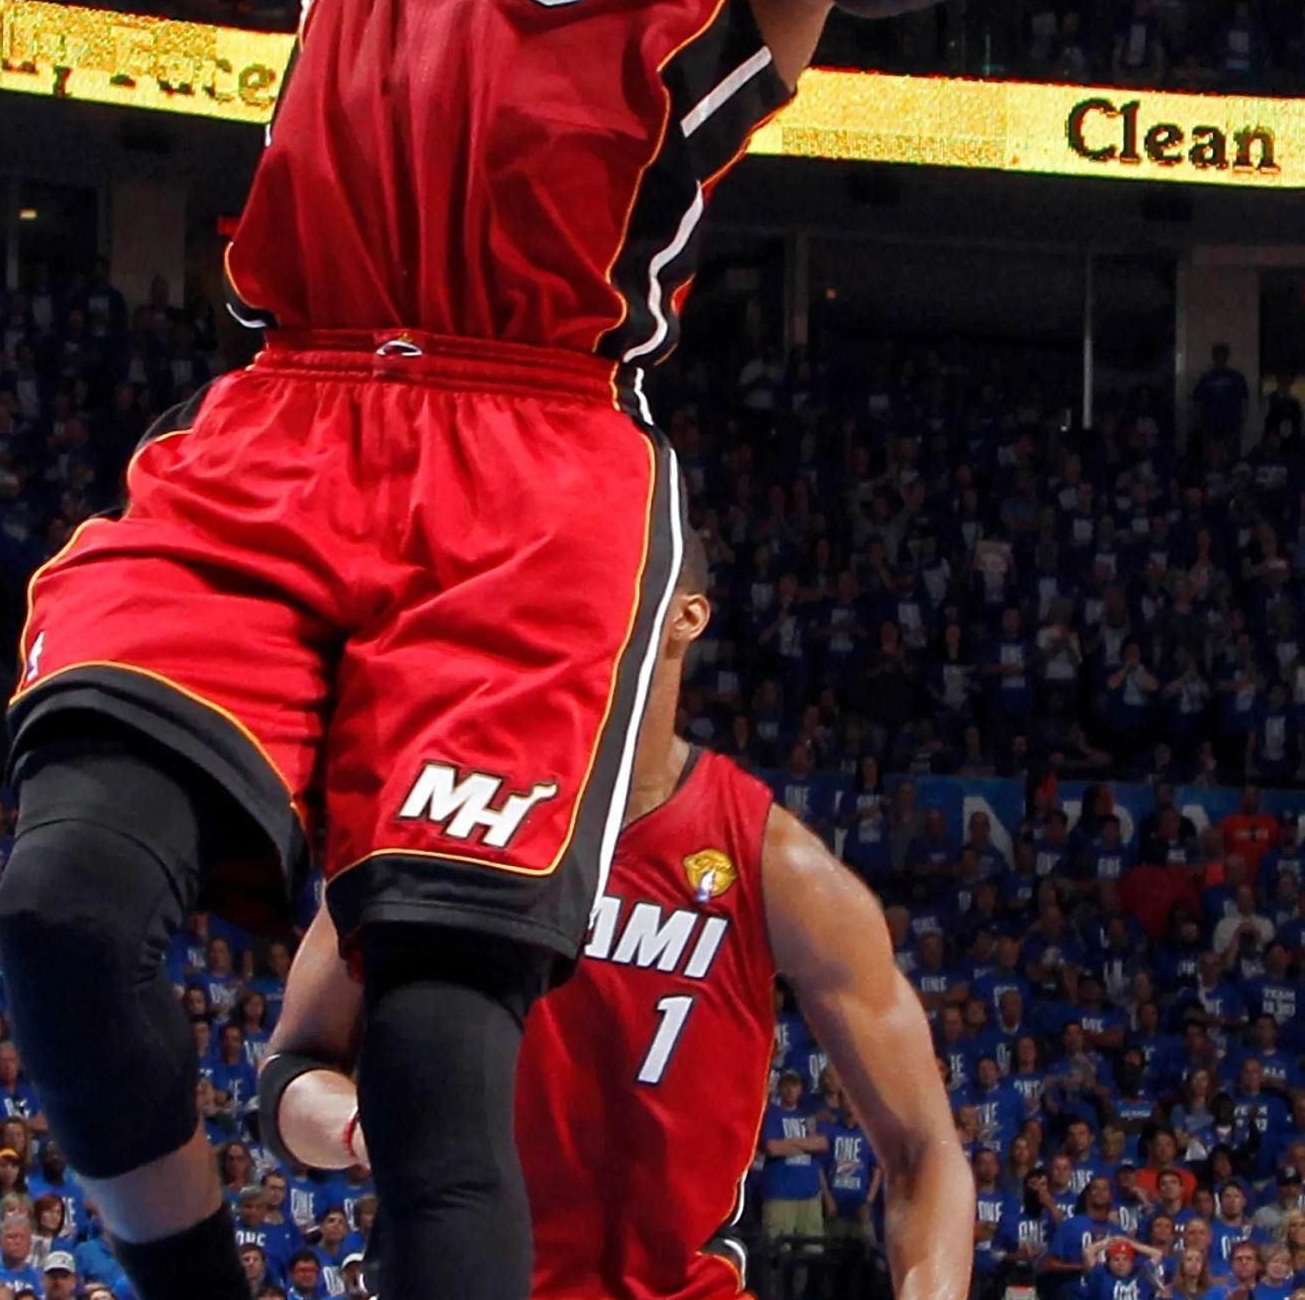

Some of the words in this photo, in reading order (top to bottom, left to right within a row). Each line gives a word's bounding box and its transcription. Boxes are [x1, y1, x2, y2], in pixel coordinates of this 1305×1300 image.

[1066, 97, 1281, 175] Clean
[585, 896, 729, 979] AMI
[635, 994, 693, 1085] 1
[835, 1137, 861, 1161] ONE
